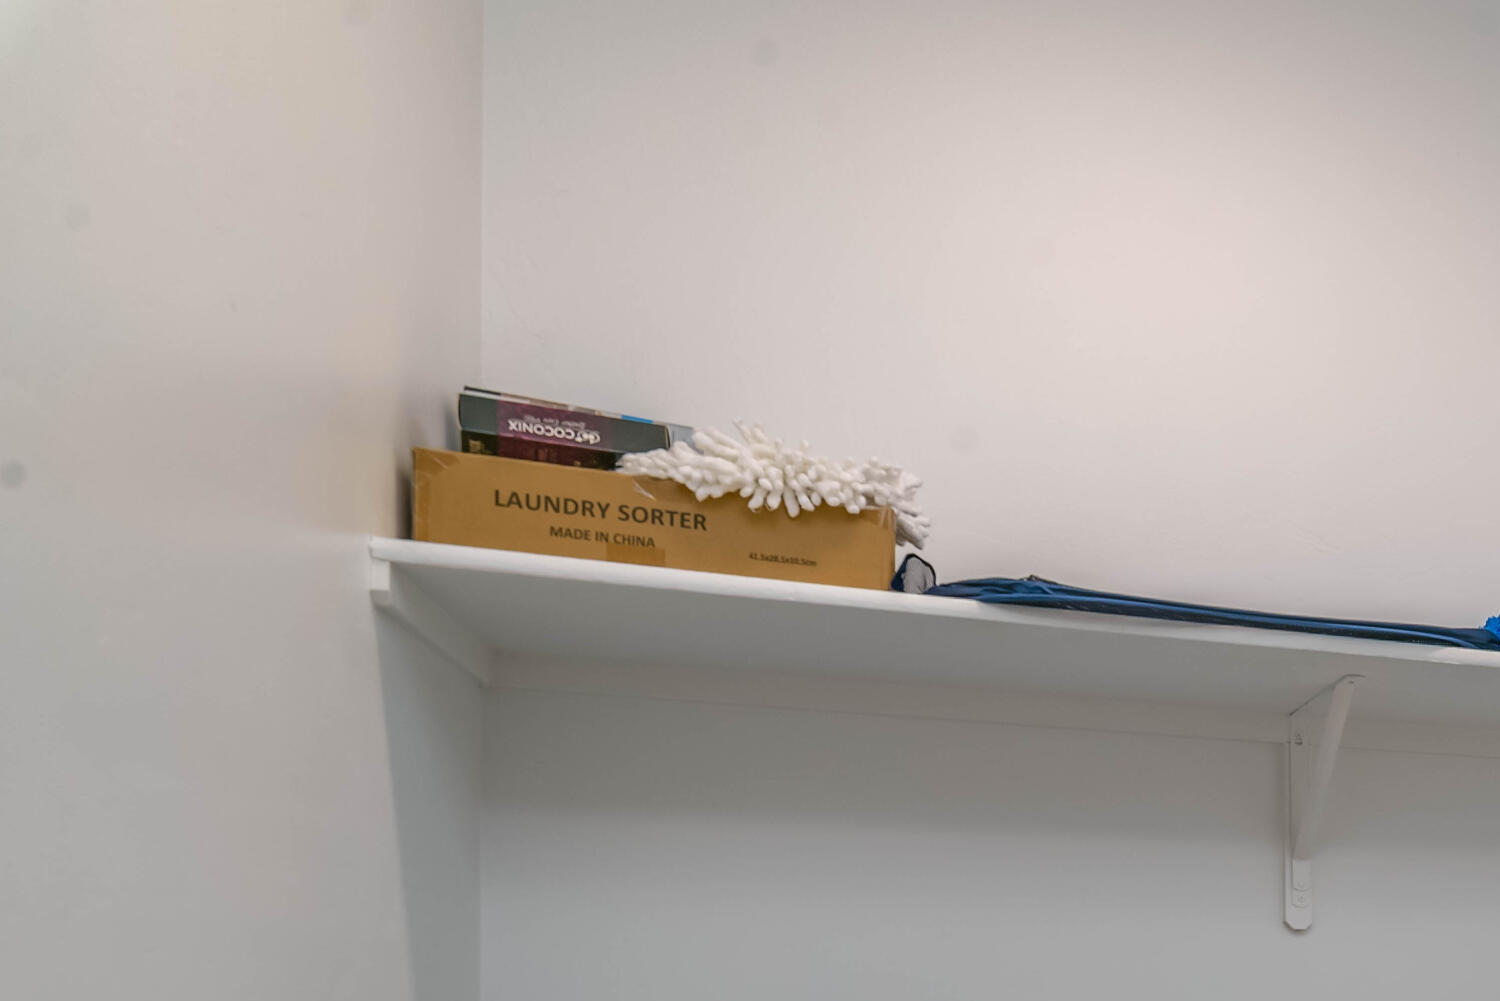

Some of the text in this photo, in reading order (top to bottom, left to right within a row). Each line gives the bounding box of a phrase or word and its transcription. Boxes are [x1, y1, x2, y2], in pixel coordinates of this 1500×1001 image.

[507, 418, 576, 442] COCONIX
[494, 489, 707, 531] LAUNDRY SORTER
[549, 526, 656, 548] MADE IN CHINA
